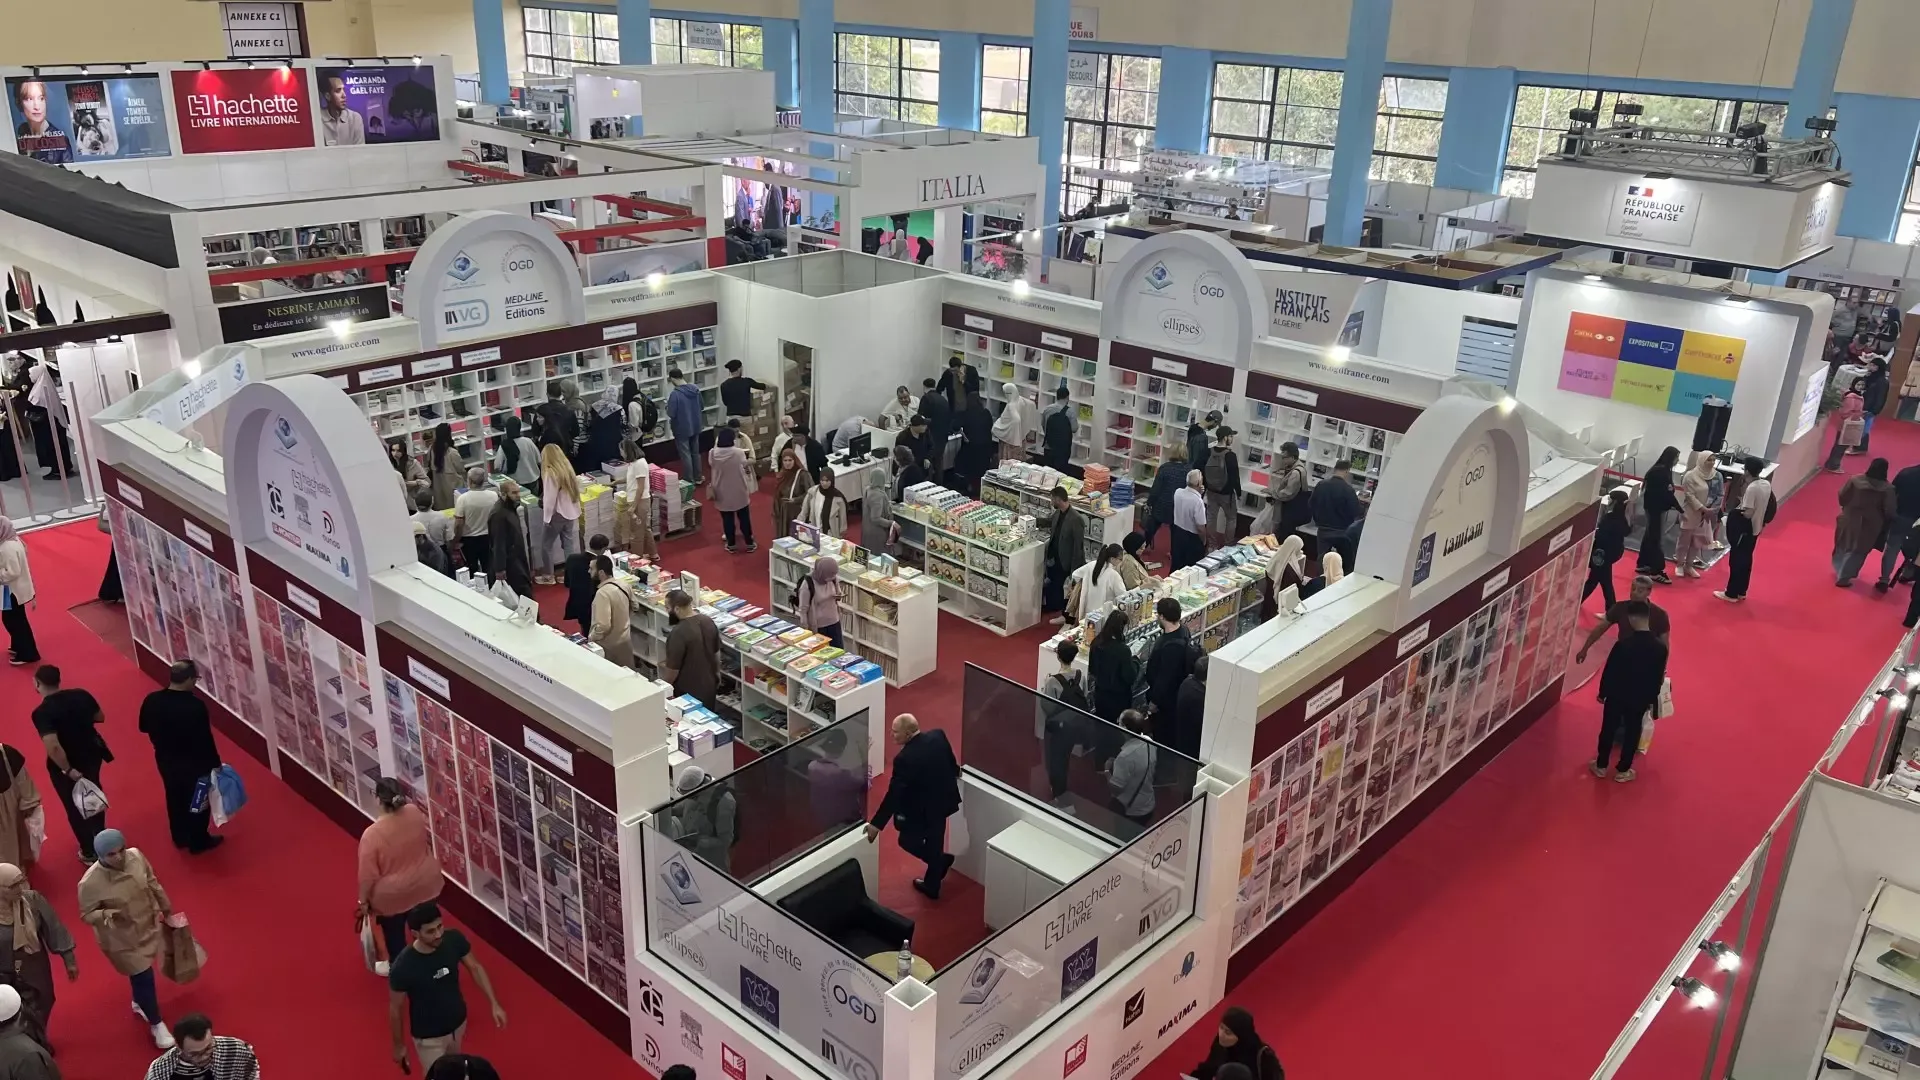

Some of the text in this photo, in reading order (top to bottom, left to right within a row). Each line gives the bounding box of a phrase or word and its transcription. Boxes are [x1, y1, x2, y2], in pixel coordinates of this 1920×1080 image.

[273, 39, 284, 47] C1
[346, 76, 387, 84] JACARANDA
[368, 86, 385, 94] FAYE
[213, 97, 298, 115] hachette
[191, 114, 300, 128] LIVRE INTERNATIONAL
[921, 174, 985, 202] ITALIA
[1623, 207, 1679, 222] FRANÇAISE
[1625, 198, 1685, 213] RÉPUBLIQUE
[509, 259, 534, 272] OGD
[504, 291, 544, 305] MED-LINE
[1200, 285, 1224, 298] OGD
[1275, 288, 1328, 310] INSTITUT
[267, 296, 361, 317] NESRINE AMMARI
[459, 306, 481, 322] VG
[505, 306, 545, 320] Editions
[1274, 300, 1330, 323] FRANÇAIS
[253, 323, 262, 331] En
[264, 319, 293, 329] dédicace
[305, 315, 312, 324] le
[1163, 317, 1200, 335] ellipses
[291, 337, 380, 359] www.ogdfrance.com
[1628, 337, 1659, 349] EXPOSITION
[1308, 361, 1390, 384] www.ogdfrance.com
[189, 379, 219, 403] hachette
[302, 472, 332, 497] hachette
[1465, 465, 1485, 486] OGD
[1443, 521, 1485, 557] tamtam
[1151, 838, 1182, 870] OGD
[1068, 874, 1122, 921] hachette
[1067, 907, 1093, 935] LIVRE
[1153, 898, 1174, 925] VG
[663, 931, 705, 968] ellipses
[740, 915, 802, 971] hachette
[740, 935, 769, 964] LIVRE
[833, 984, 877, 1024] OGD
[1157, 999, 1198, 1040] MAXIMA
[959, 1027, 1006, 1071] ellipses
